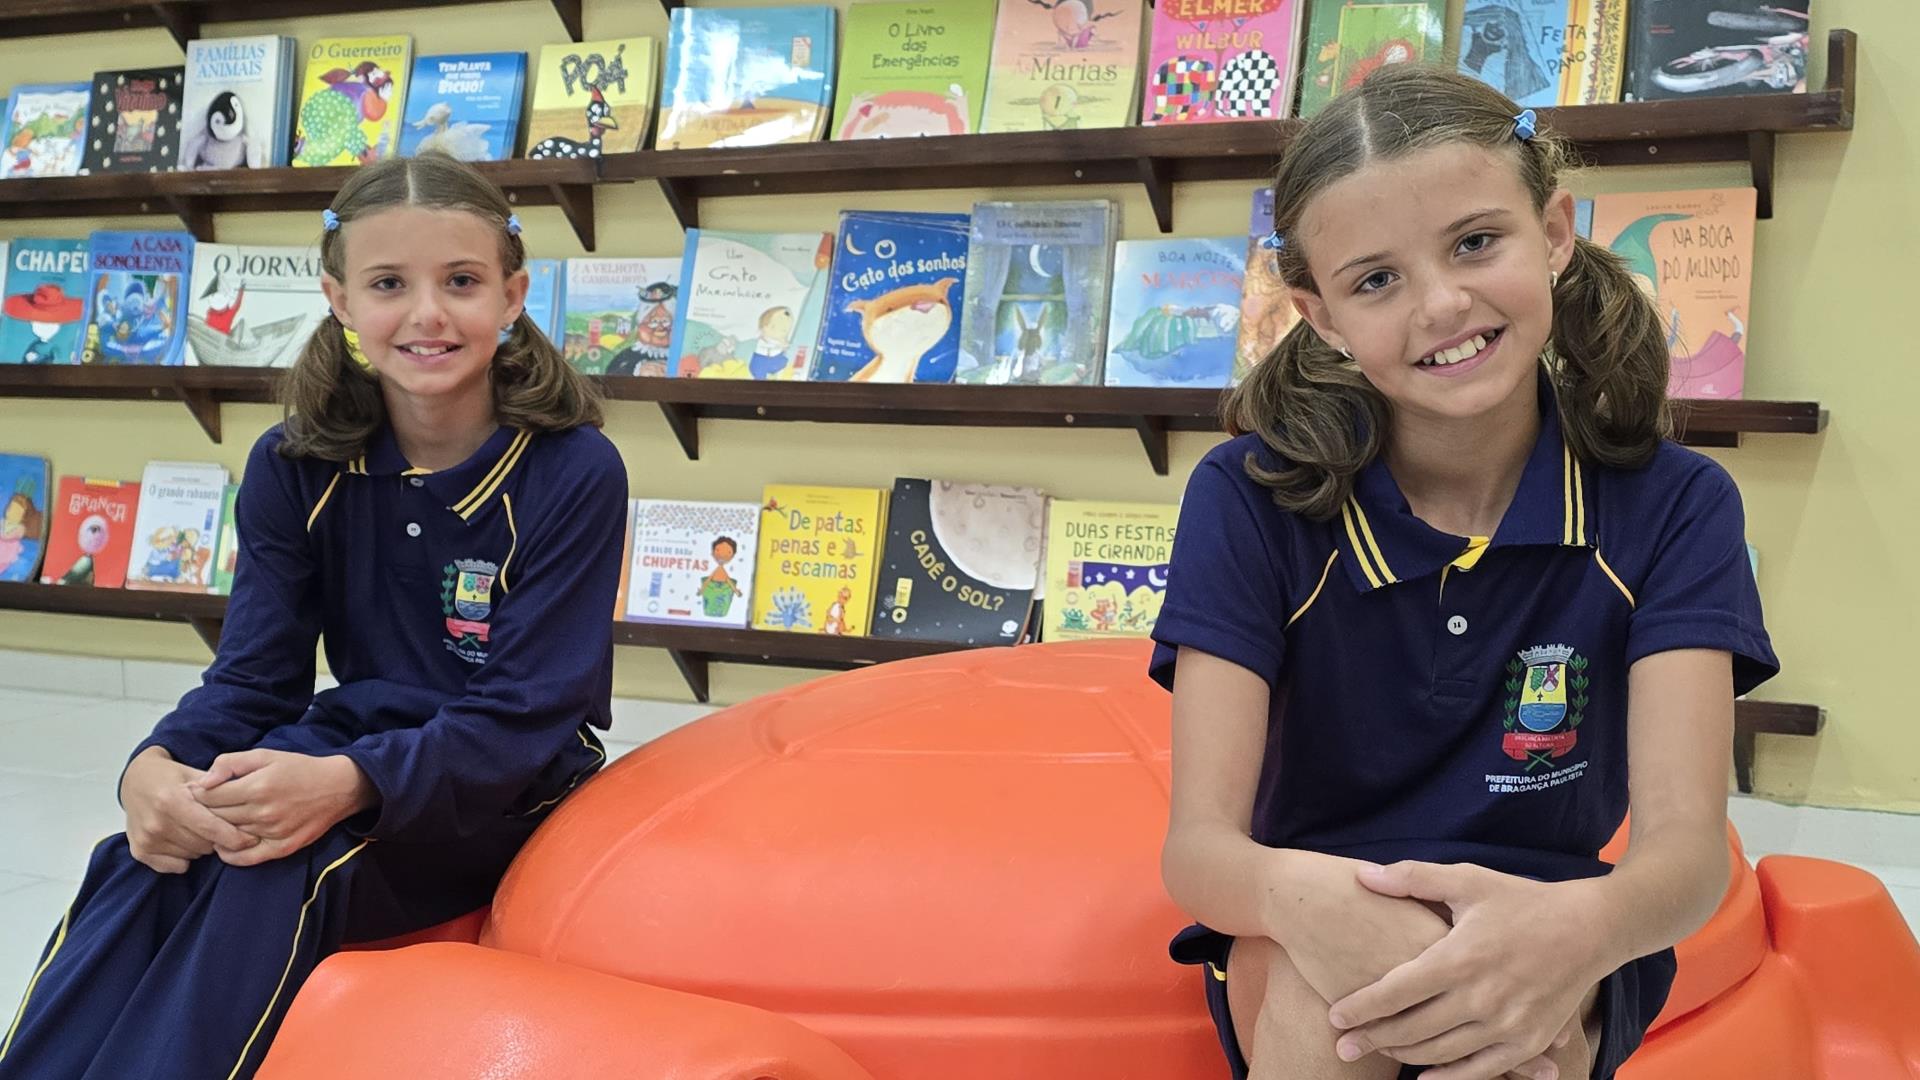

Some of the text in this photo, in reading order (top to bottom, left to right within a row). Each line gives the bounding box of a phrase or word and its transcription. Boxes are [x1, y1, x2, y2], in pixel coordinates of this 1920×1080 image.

[1180, 0, 1264, 16] ELMER
[888, 22, 945, 38] O Livro
[1176, 29, 1264, 50] WILBUR
[1540, 24, 1588, 45] FEITA
[195, 42, 267, 63] FAMÍLIAS
[312, 42, 402, 59] O Guerreiro
[902, 38, 928, 52] das
[197, 61, 263, 78] ANIMAIS
[458, 61, 491, 71] PLANTA
[872, 53, 960, 70] Emergências
[1030, 57, 1118, 81] Marias
[1546, 51, 1587, 76] PANO
[438, 80, 485, 94] BICHO!
[132, 236, 182, 252] A CASA
[1672, 224, 1734, 248] NA BOCA
[95, 255, 182, 271] SONOLENTA
[213, 254, 231, 274] O
[1158, 251, 1186, 263] BOA
[592, 263, 647, 274] VELHOTA
[708, 266, 757, 282] Gato
[842, 252, 966, 291] Gato dos sonhos
[1663, 254, 1740, 284] DO MUNDO
[69, 492, 127, 523] BRANCA
[790, 509, 866, 537] De patas,
[1065, 521, 1176, 543] DUAS FESTAS
[769, 537, 836, 558] penas e
[1073, 541, 1093, 558] DE
[642, 555, 709, 572] CHUPETAS
[782, 557, 857, 579] escamas
[910, 530, 1004, 612] CADÊ O SOL?
[1485, 760, 1588, 785] PREFEITURA DO MUNICÍPIO
[1489, 770, 1584, 793] DE BRAGANÇA PAULISTA
